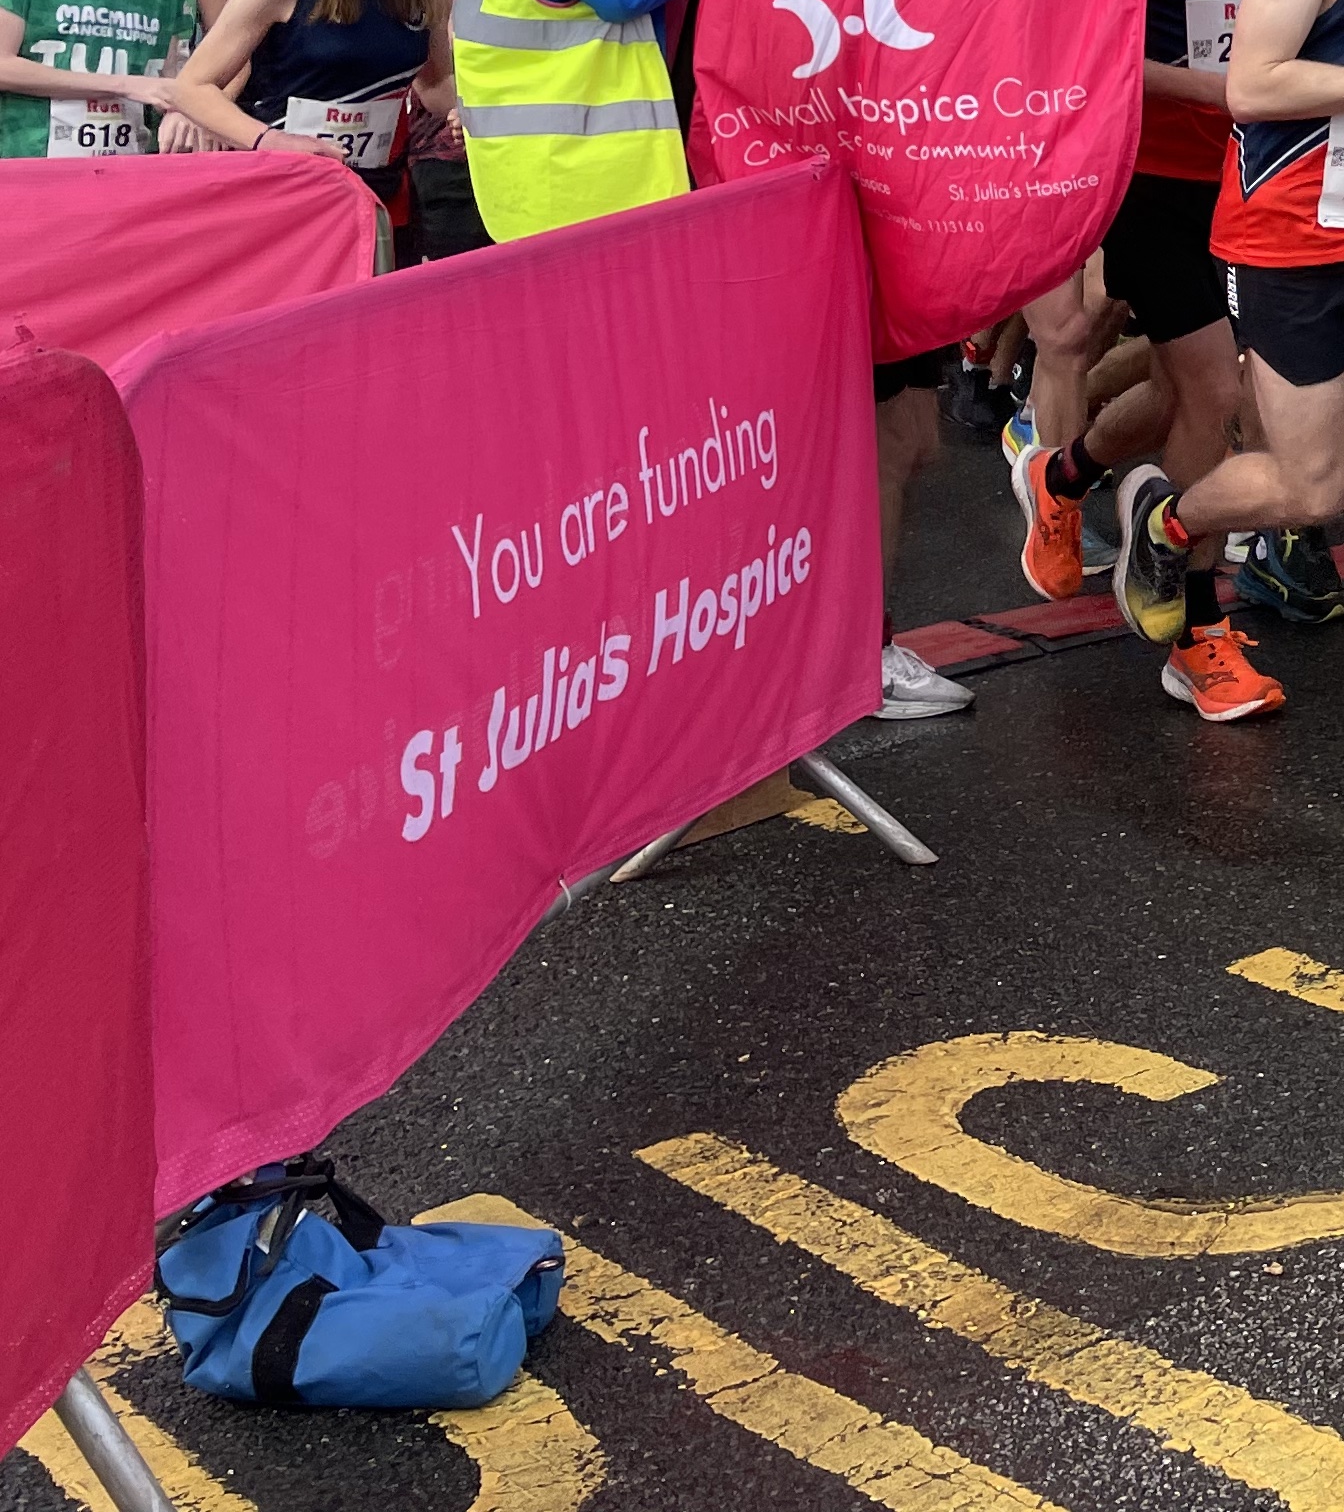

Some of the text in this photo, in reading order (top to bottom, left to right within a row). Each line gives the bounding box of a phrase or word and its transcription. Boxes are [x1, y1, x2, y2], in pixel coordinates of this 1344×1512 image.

[325, 108, 364, 123] Run
[710, 86, 836, 144] ornwall
[992, 77, 1088, 119] Care
[78, 123, 132, 148] 618
[866, 143, 894, 162] our
[904, 131, 1046, 169] community
[948, 173, 1099, 203] St. Julia's Hospice
[927, 219, 985, 234] 1113140
[1226, 266, 1240, 320] TERREX
[451, 511, 544, 619] You
[560, 482, 629, 567] are
[638, 397, 779, 526] funding
[400, 724, 464, 843] St
[646, 525, 813, 677] Hospice
